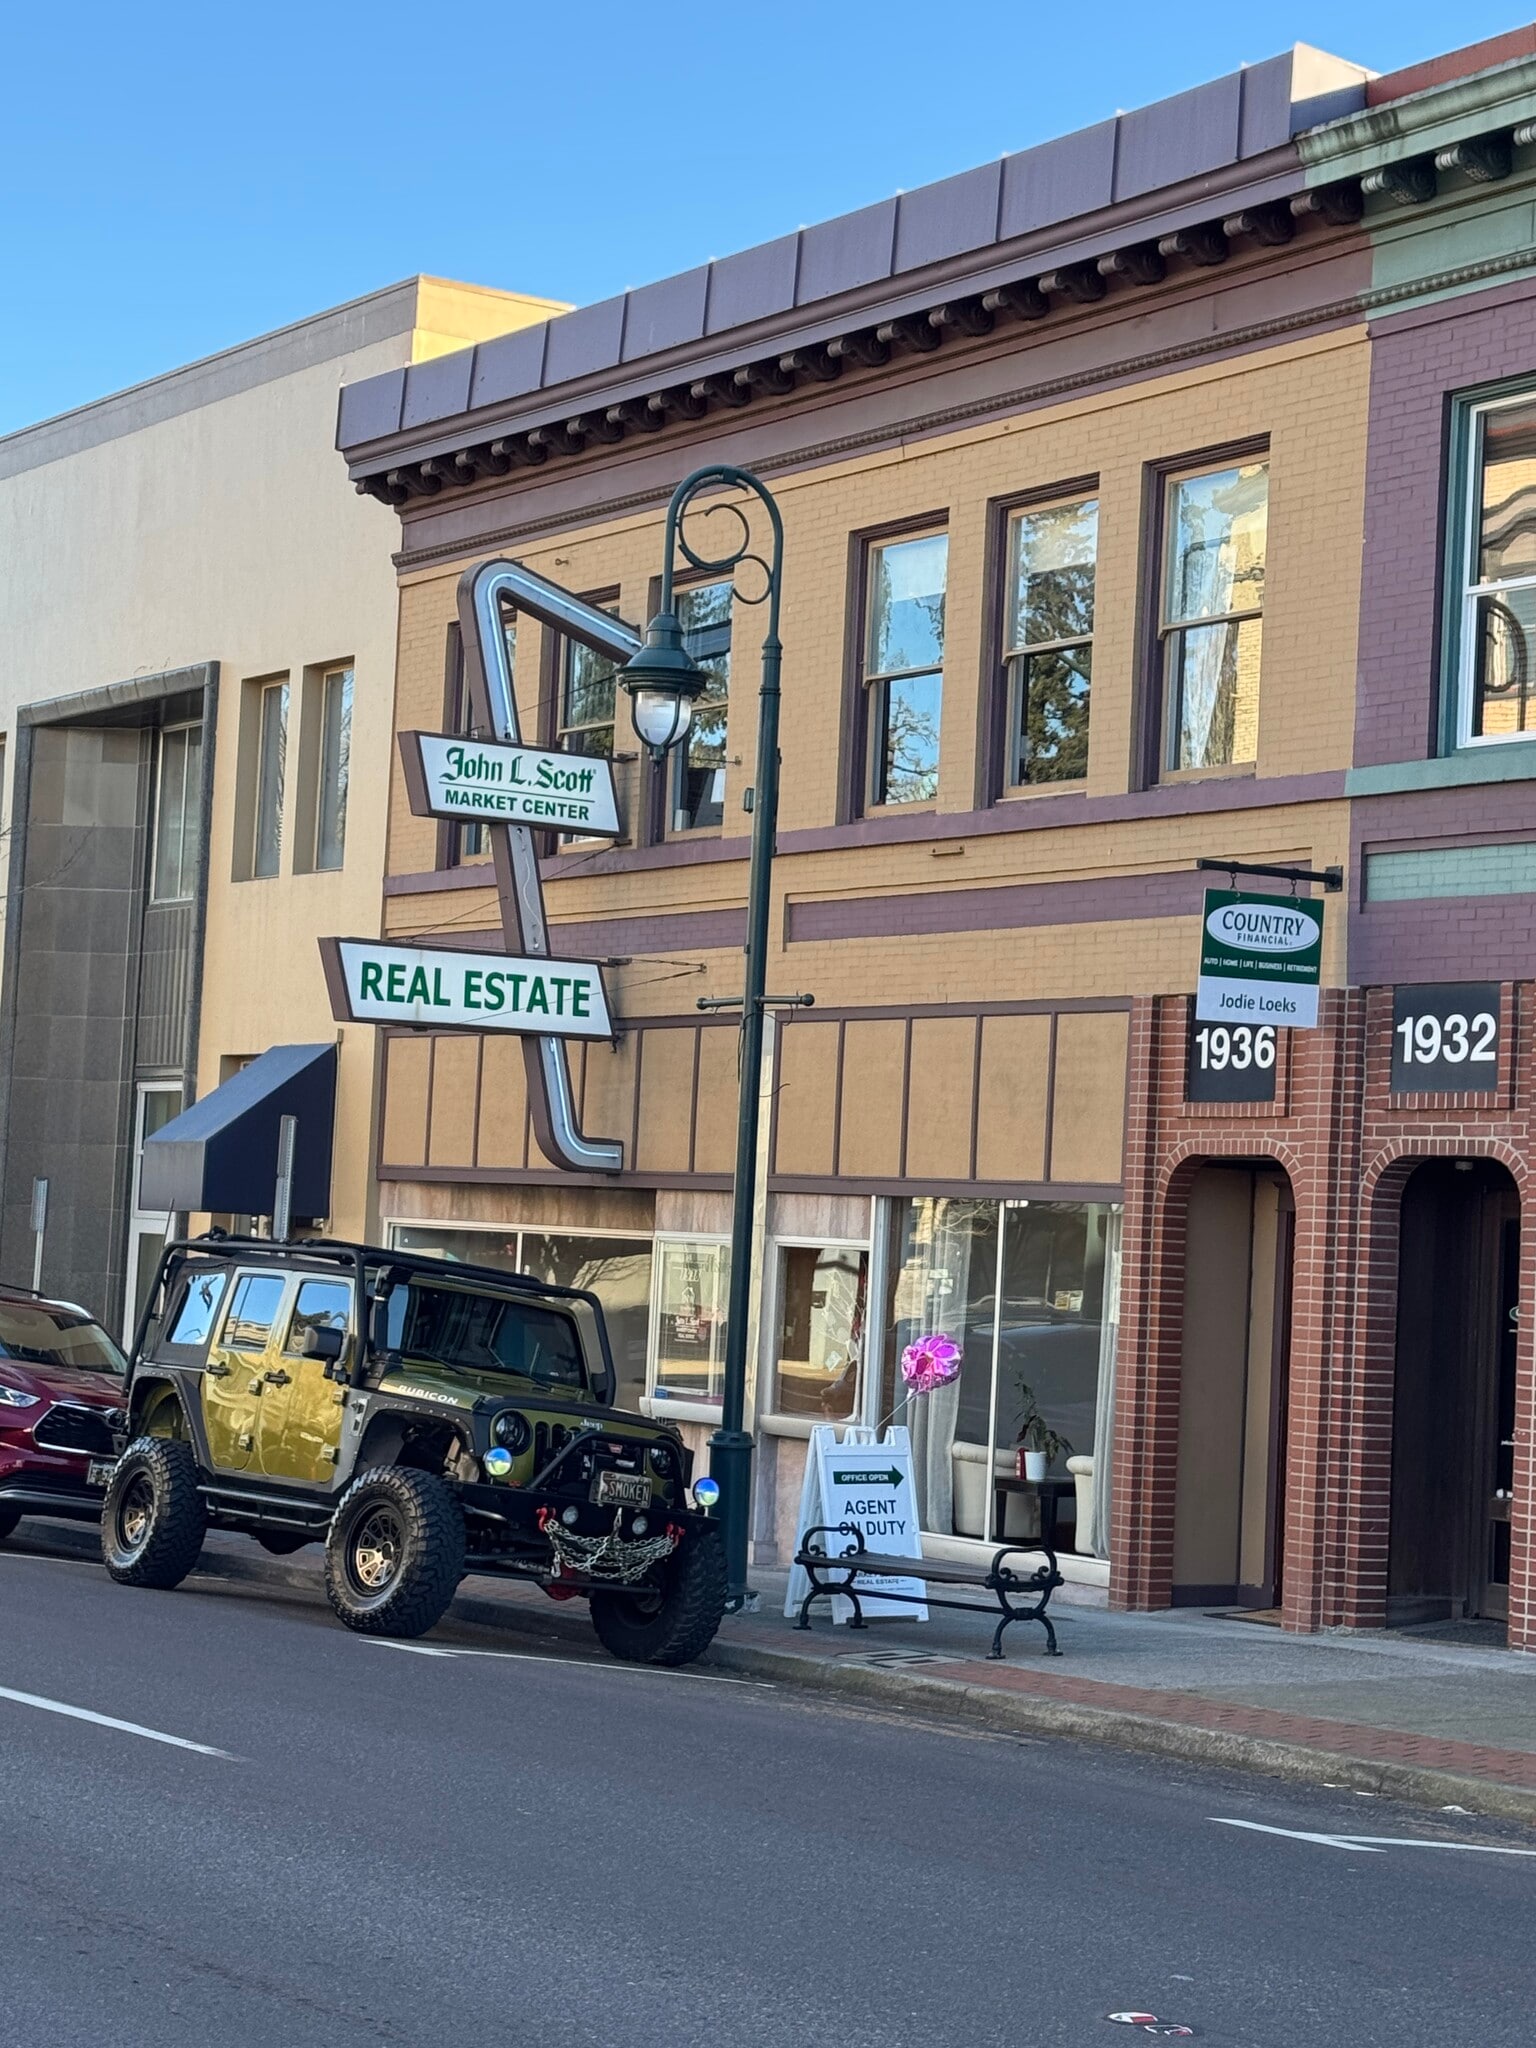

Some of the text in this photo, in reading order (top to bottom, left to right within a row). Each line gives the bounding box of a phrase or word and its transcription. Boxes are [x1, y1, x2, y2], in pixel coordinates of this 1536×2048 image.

[439, 746, 503, 781] John
[533, 758, 594, 793] Scott
[444, 789, 590, 820] MARKET CENTER
[1222, 910, 1305, 936] COUNTRY
[1237, 933, 1289, 946] FINANCIAL
[360, 961, 591, 1017] REAL ESTATE
[1220, 993, 1296, 1013] Jodie Loeks
[1195, 1025, 1276, 1070] 1936
[1397, 1012, 1497, 1064] 1932
[399, 1384, 459, 1405] RUBICON
[608, 1481, 650, 1501] SMOKEN
[844, 1500, 896, 1515] AGENT
[866, 1520, 906, 1536] DUTY
